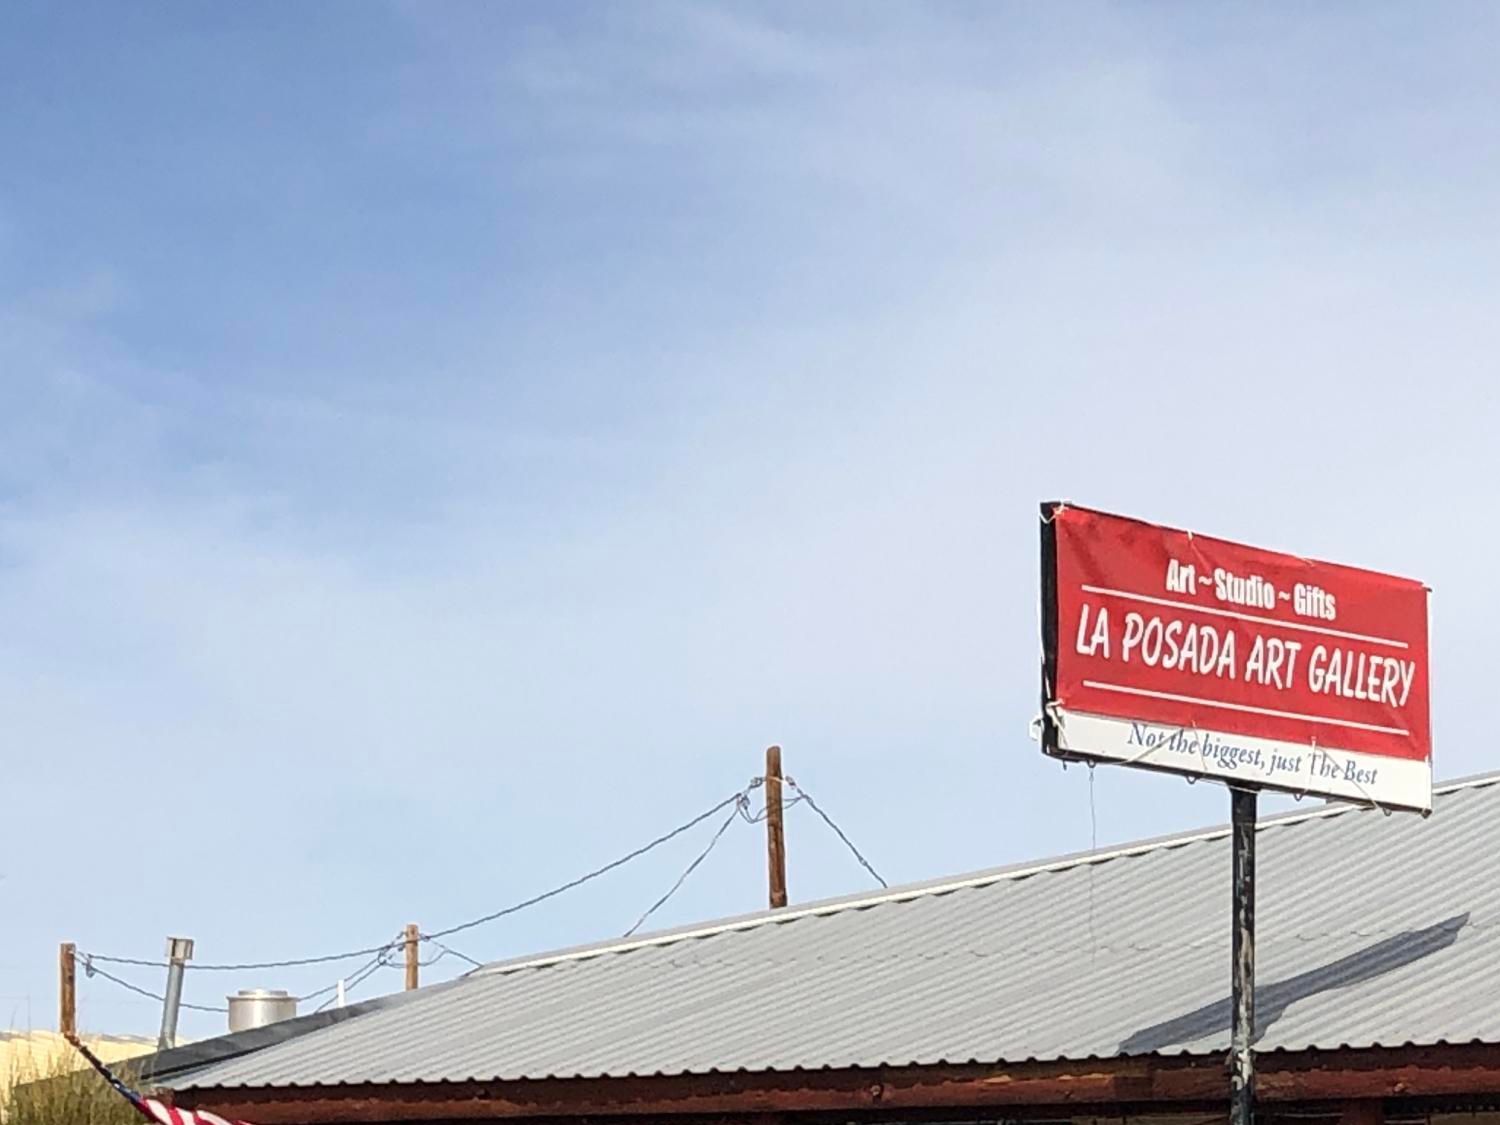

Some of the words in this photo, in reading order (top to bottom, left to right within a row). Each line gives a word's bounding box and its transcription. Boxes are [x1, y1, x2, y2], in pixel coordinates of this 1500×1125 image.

[1166, 558, 1197, 596] Art
[1214, 568, 1275, 609] Studio
[1293, 582, 1337, 621] Gifts
[1076, 603, 1110, 659] LA
[1122, 612, 1236, 679] POSADA
[1245, 635, 1302, 690] ART
[1308, 645, 1415, 708] GALLERY
[1128, 722, 1164, 749] Not
[1168, 731, 1199, 756] the
[1202, 737, 1266, 770] biggest,
[1268, 751, 1302, 775] just
[1310, 752, 1341, 779] The
[1344, 760, 1379, 786] Best
